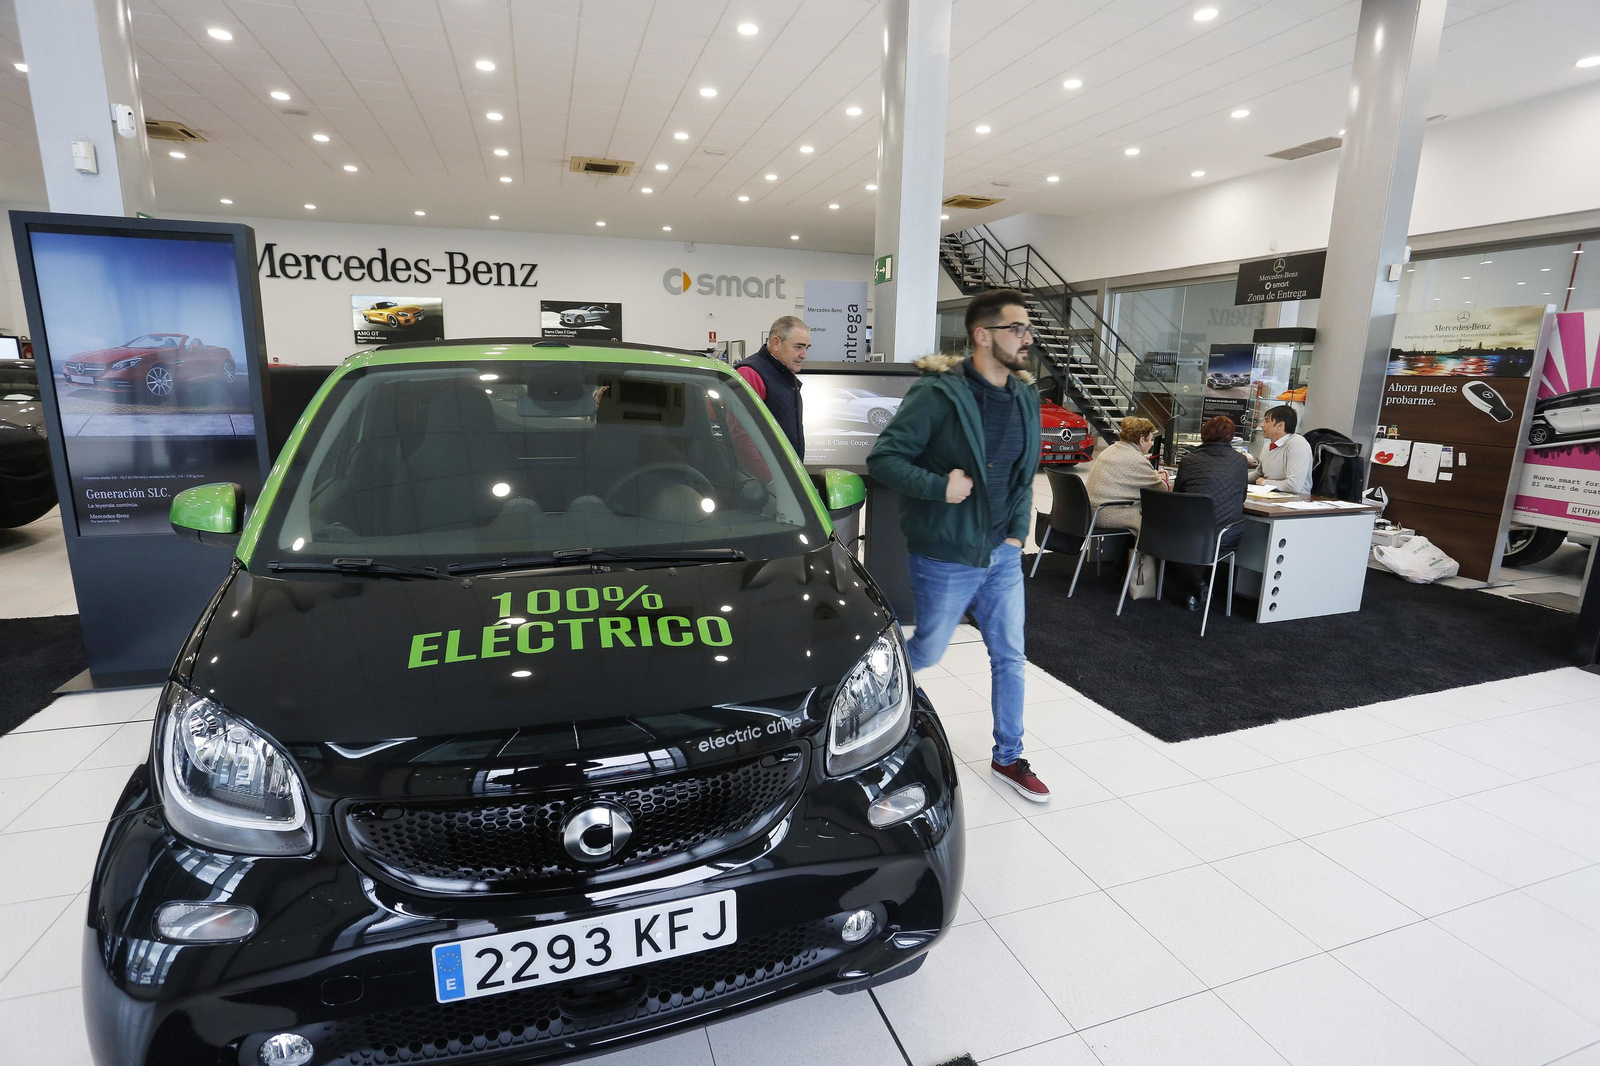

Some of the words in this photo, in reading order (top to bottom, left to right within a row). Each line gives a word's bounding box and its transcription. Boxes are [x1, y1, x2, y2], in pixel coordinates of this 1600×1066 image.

[1258, 271, 1299, 282] Mercedes-Benz
[697, 273, 786, 299] smart
[1272, 280, 1290, 289] smart
[1247, 293, 1265, 302] Zona
[1266, 291, 1276, 300] de
[1277, 289, 1307, 300] Entrega
[842, 304, 862, 362] ntrega
[1433, 323, 1492, 332] Mercedes-Benz
[1387, 383, 1418, 392] Ahora
[1419, 383, 1458, 395] puedes
[1385, 395, 1436, 406] probarme.
[1585, 480, 1600, 488] for
[86, 487, 145, 500] Generación
[147, 487, 171, 498] SLC.
[95, 502, 115, 510] leyenda
[1571, 504, 1600, 517] grupo
[491, 585, 664, 618] 100%
[408, 615, 733, 669] ELÉCTRICO
[698, 726, 762, 752] electric
[766, 717, 802, 735] drive
[474, 927, 612, 991] 2293
[634, 900, 727, 958] KFJ
[446, 978, 457, 991] E
